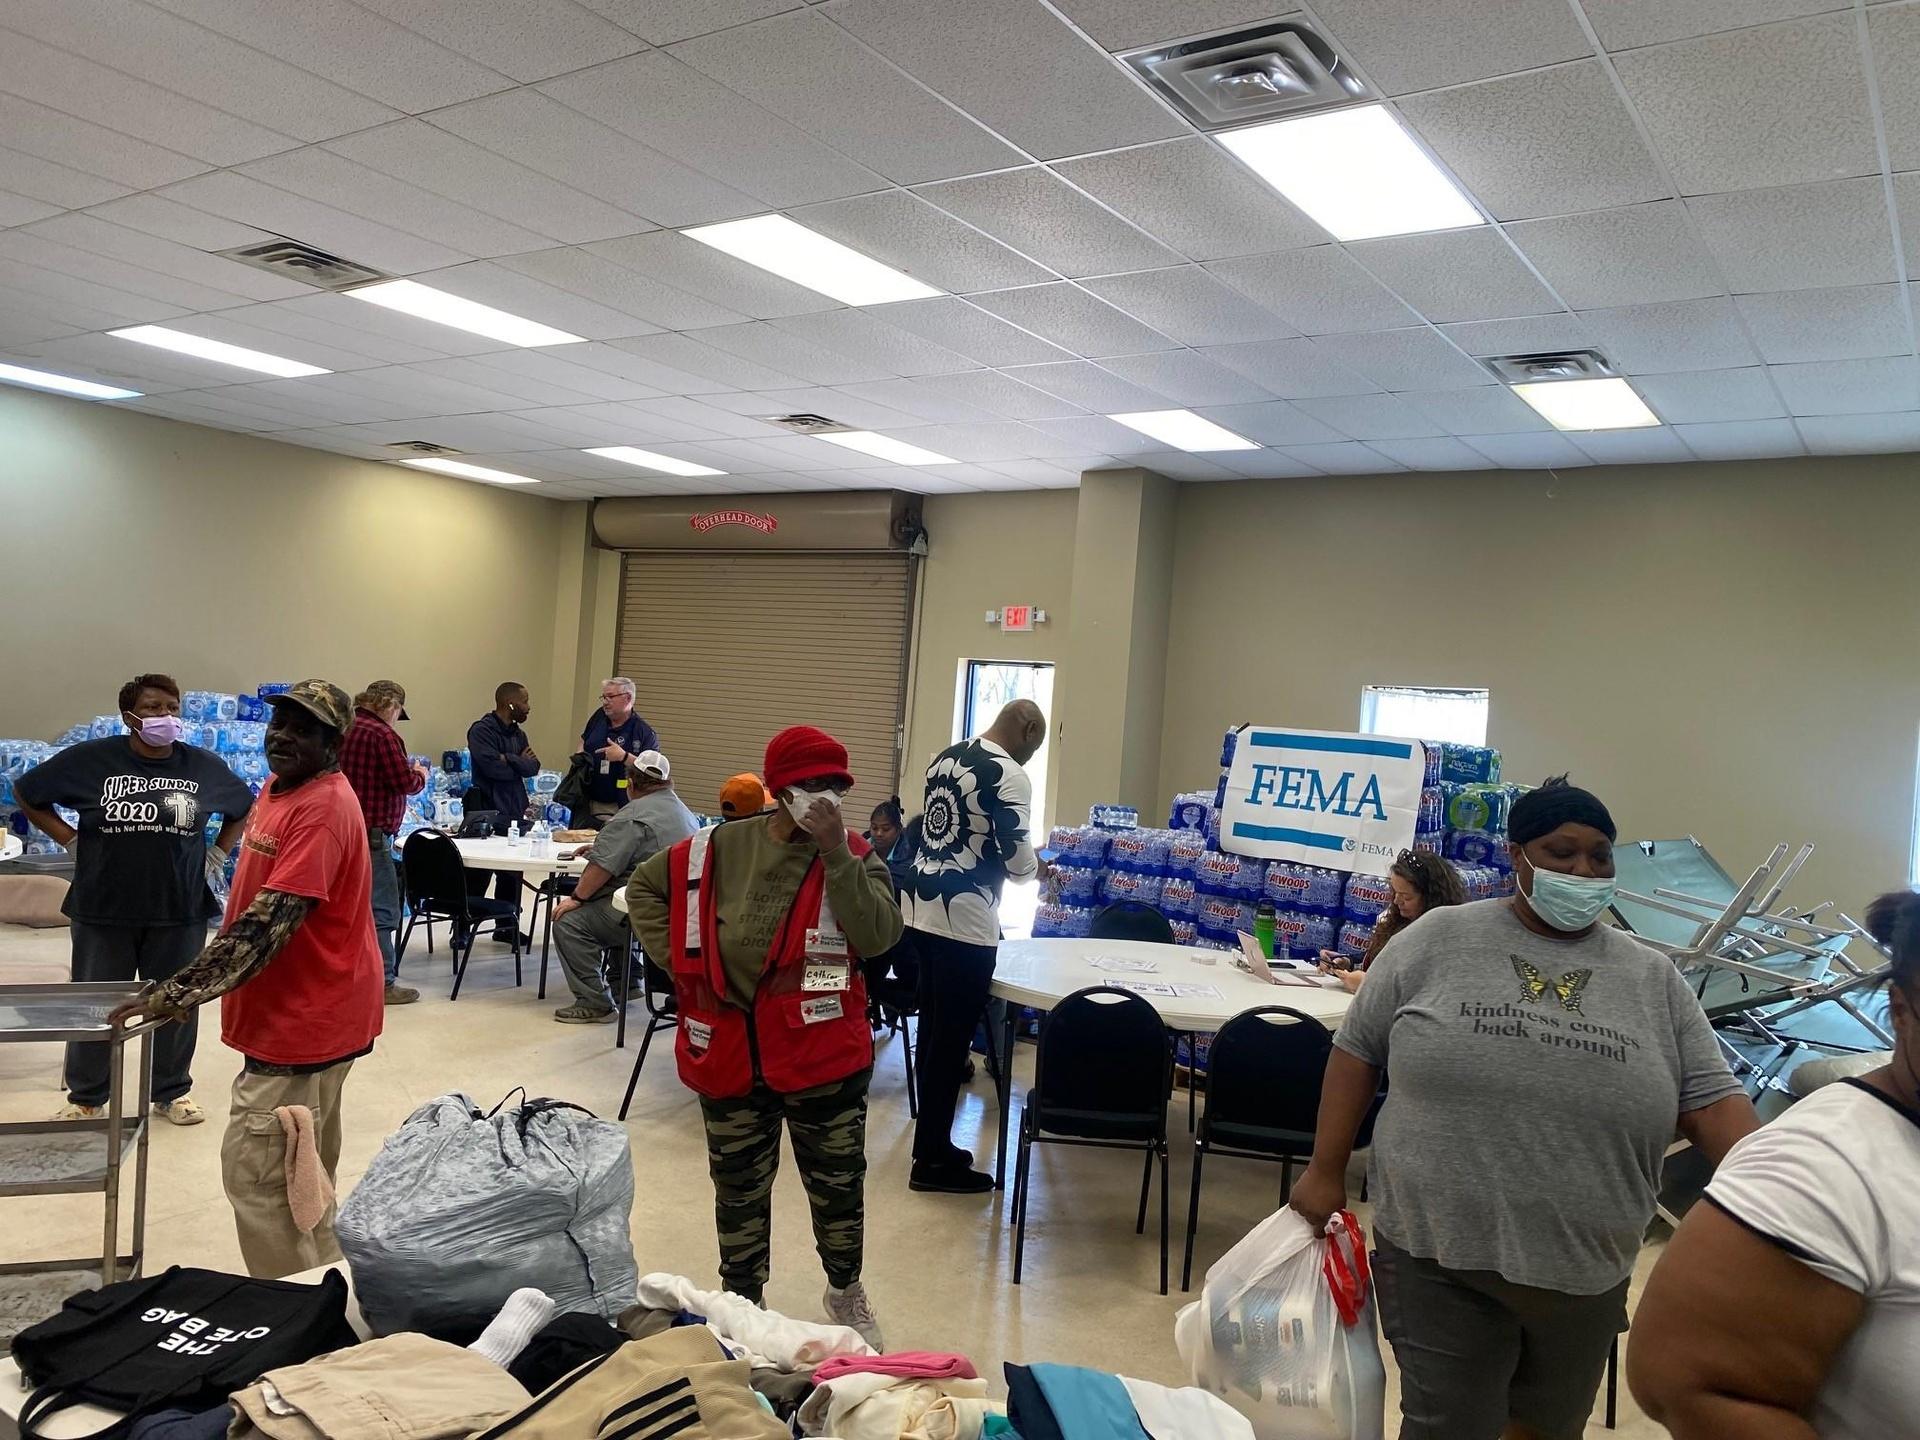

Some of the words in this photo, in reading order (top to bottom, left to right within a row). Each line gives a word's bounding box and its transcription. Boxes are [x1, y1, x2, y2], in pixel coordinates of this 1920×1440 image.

[700, 514, 743, 530] OVERHEAD
[745, 516, 769, 531] DOOR
[1006, 607, 1028, 626] EXIT
[101, 775, 148, 806] SUPER
[149, 778, 199, 793] SUNDAY
[1244, 764, 1388, 821] FEMA
[105, 801, 158, 822] 2020
[137, 823, 163, 833] through
[1361, 843, 1394, 857] FEMA
[1269, 873, 1311, 889] ATWOODS
[745, 890, 793, 905] CLOTHE
[1276, 919, 1306, 933] WOODS
[1345, 932, 1371, 948] ATWO
[1459, 1001, 1560, 1029] kindness
[1569, 1020, 1640, 1049] comes
[1473, 1018, 1529, 1039] back
[1540, 1033, 1627, 1063] around
[140, 1307, 210, 1335] BAG
[204, 1326, 271, 1343] OTE
[157, 1332, 222, 1356] THE
